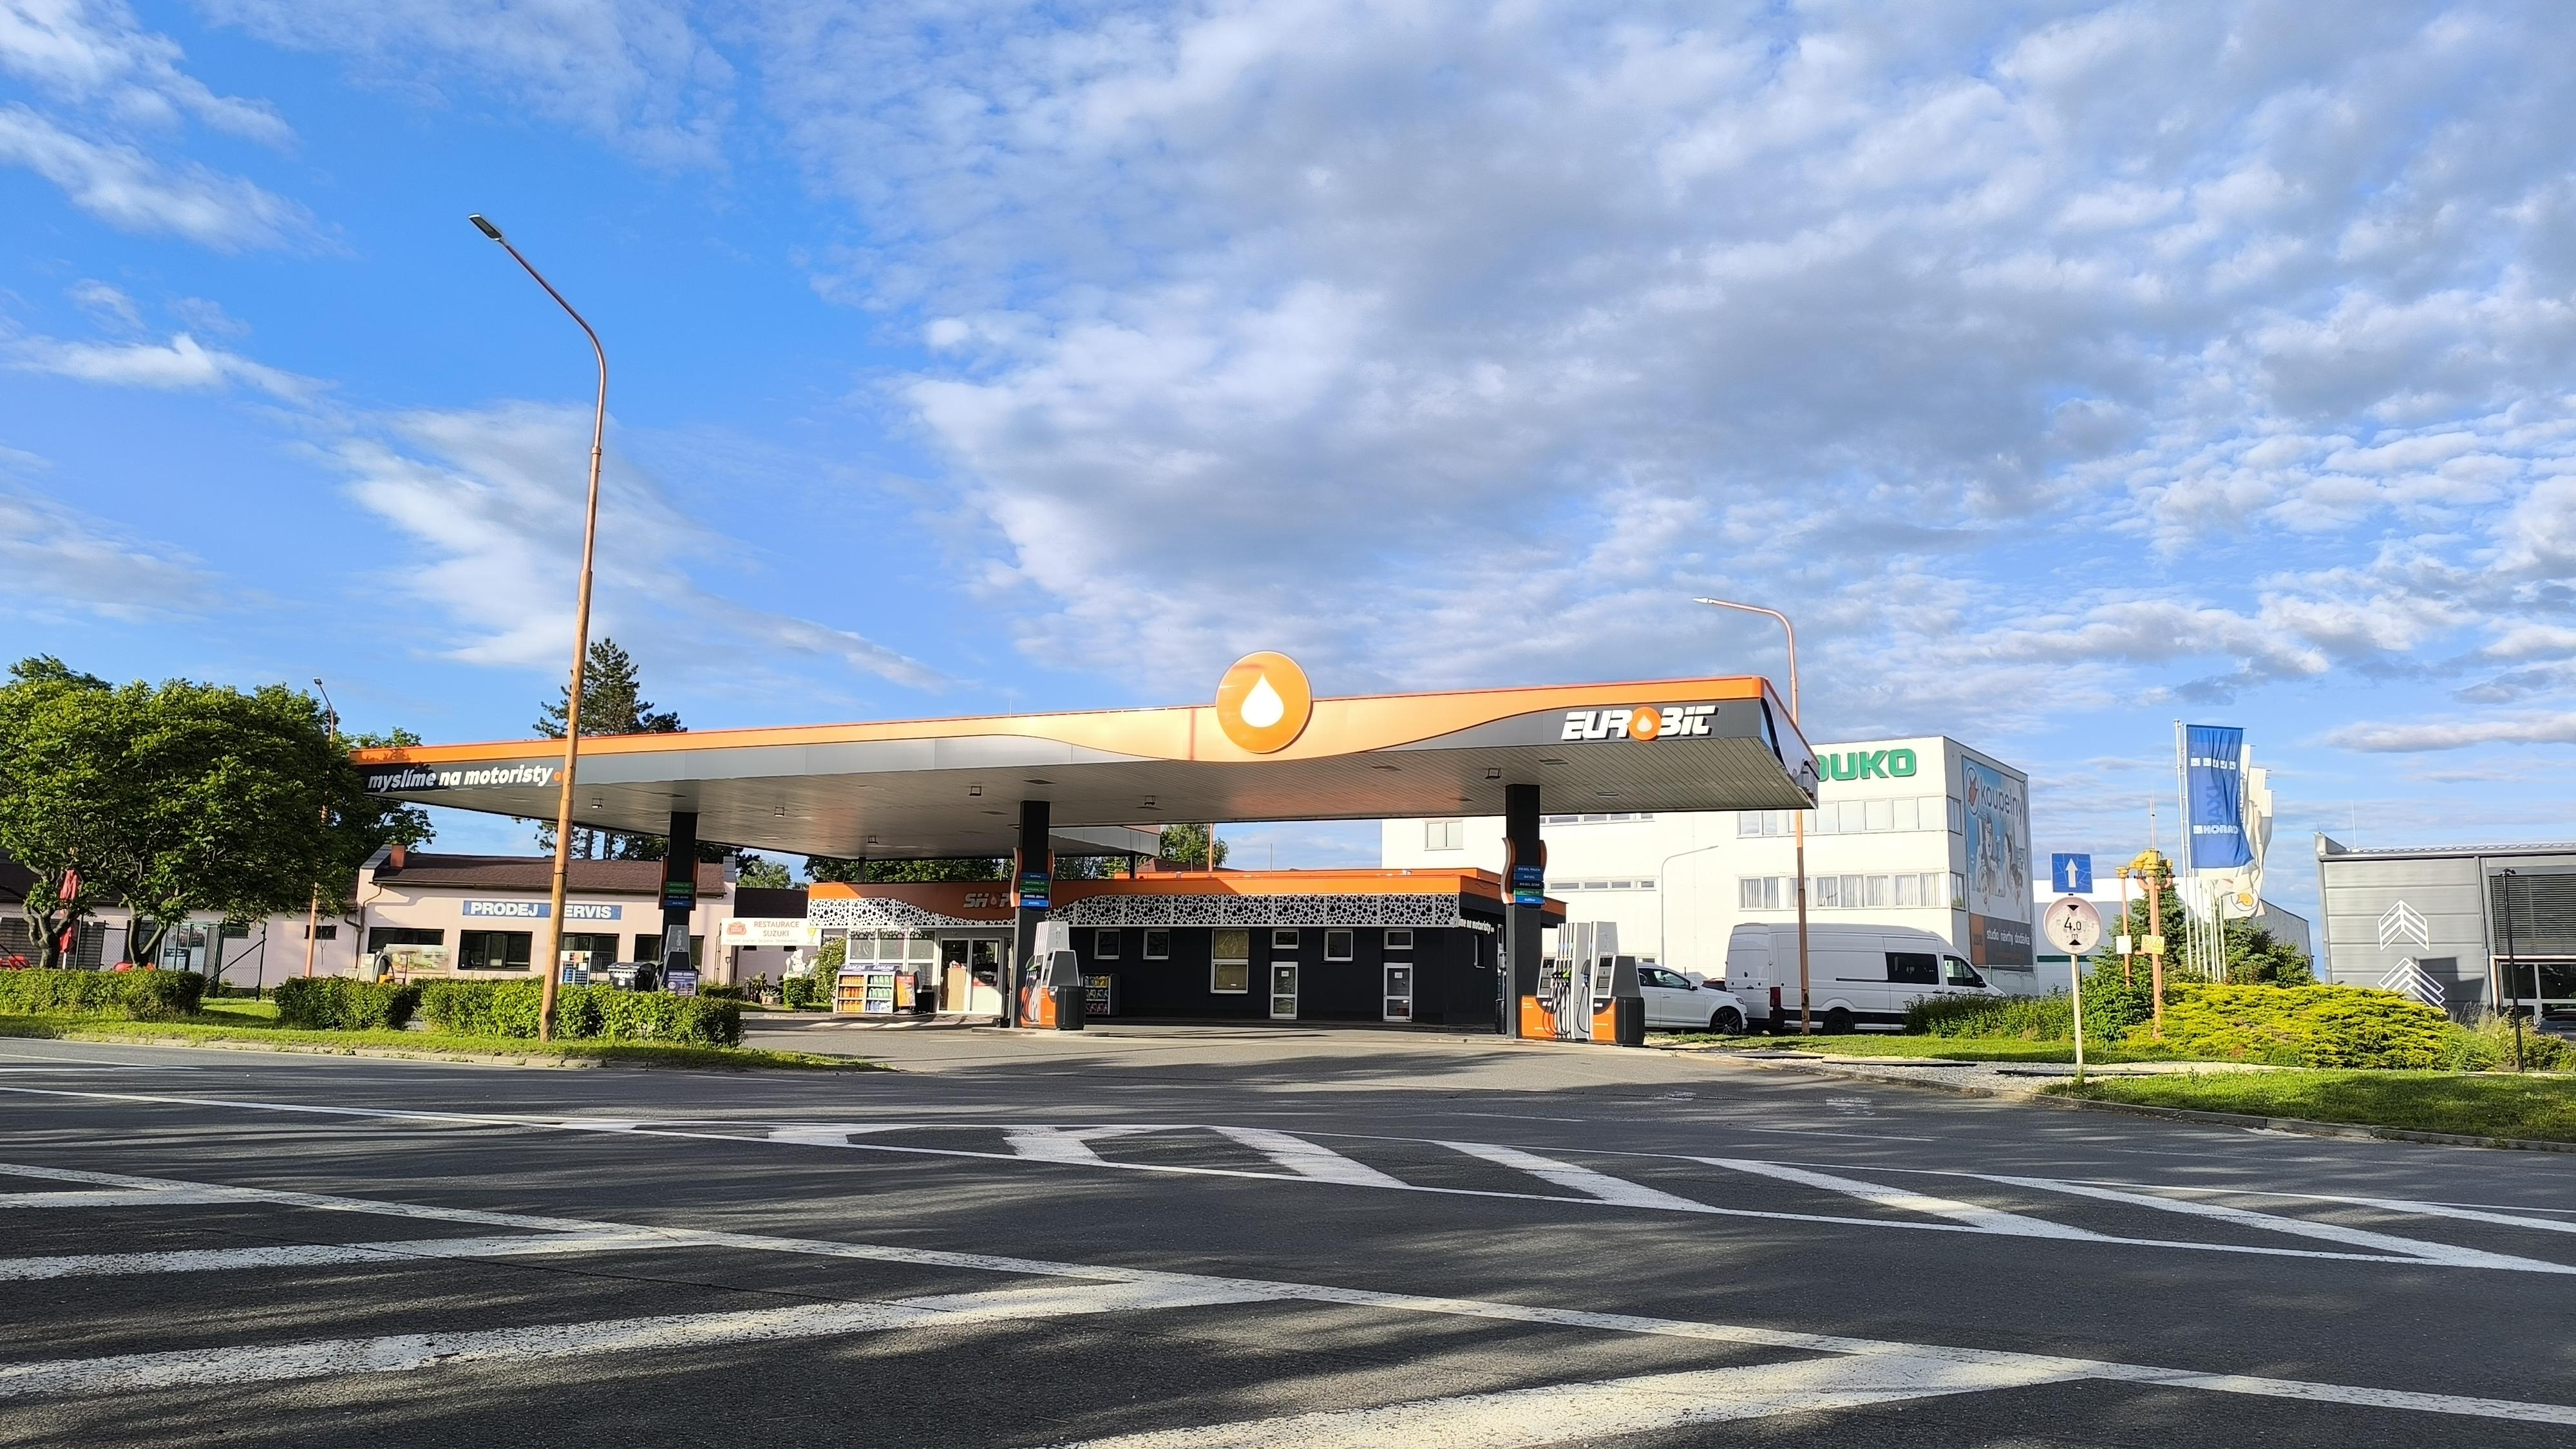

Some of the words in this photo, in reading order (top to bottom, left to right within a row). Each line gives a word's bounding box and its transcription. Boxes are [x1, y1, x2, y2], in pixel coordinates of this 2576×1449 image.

[1561, 705, 1718, 741] EUROBIT
[368, 769, 437, 793] myslíme
[439, 772, 462, 786] na
[464, 764, 554, 787] motoristy
[1980, 776, 2023, 826] koupelny
[470, 902, 538, 916] PRODEJ
[564, 905, 612, 919] ERVIS
[963, 893, 1010, 908] SHOP
[1986, 928, 2000, 941] studio
